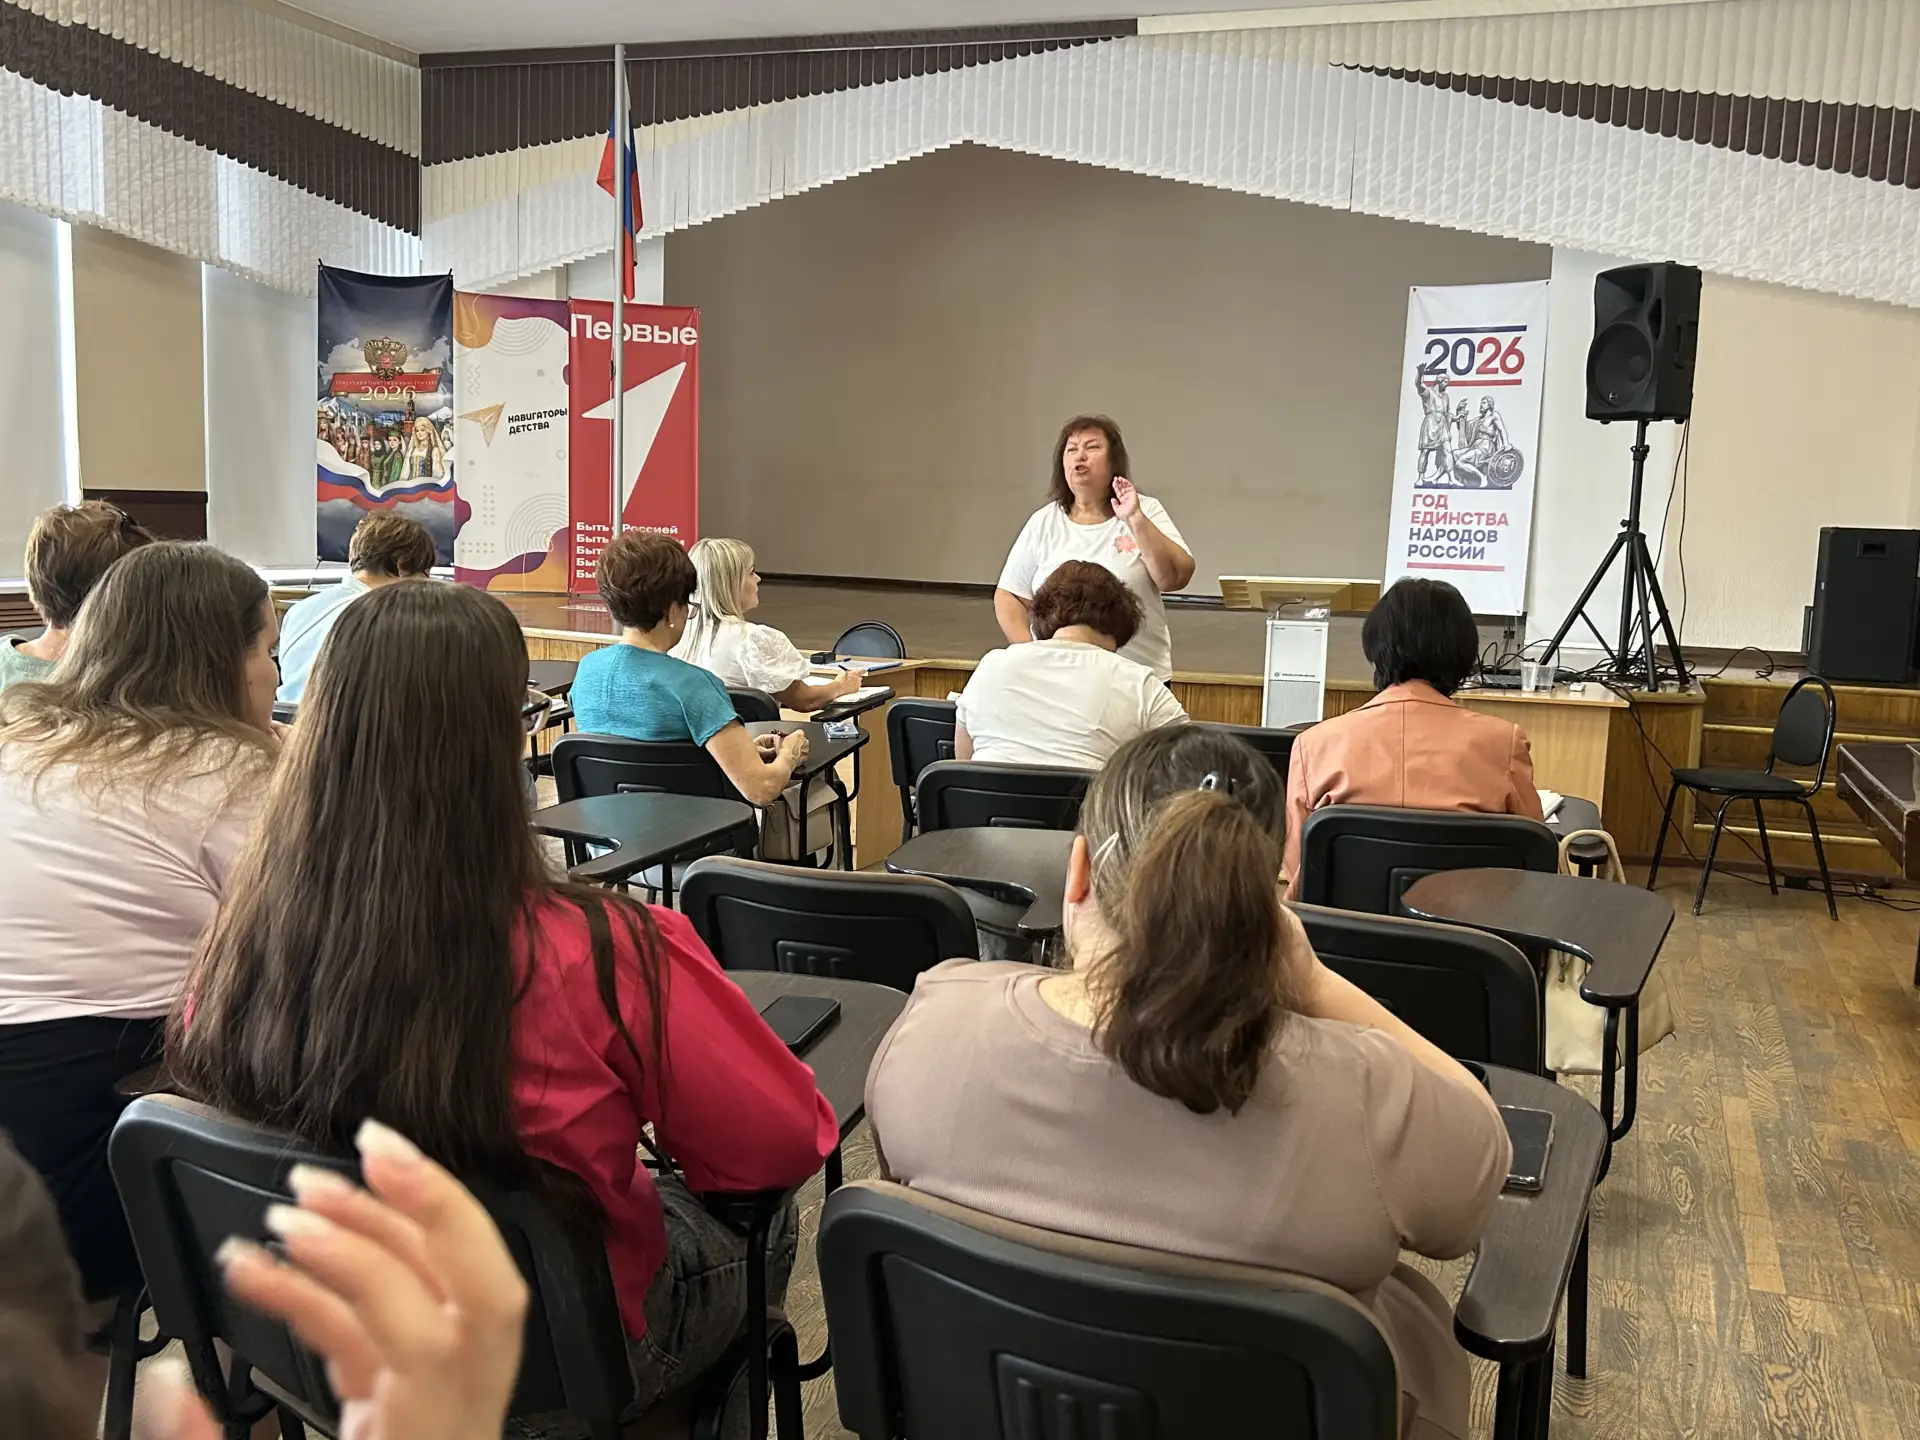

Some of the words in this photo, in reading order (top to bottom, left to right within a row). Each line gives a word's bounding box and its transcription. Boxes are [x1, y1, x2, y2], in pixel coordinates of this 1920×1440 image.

[1422, 336, 1526, 376] 2026
[360, 385, 416, 400] 2026
[508, 407, 567, 423] НАВИГАТОРЫ
[509, 421, 550, 435] ДЕТСТВА
[1412, 494, 1448, 510] ГОД
[1410, 511, 1509, 526] ЕДИНСТВА
[576, 521, 610, 532] Быть
[622, 523, 678, 534] Россией
[576, 533, 610, 543] Быть
[1409, 528, 1498, 545] НАРОДОВ
[576, 545, 604, 555] Быт
[1407, 544, 1485, 560] РОССИИ
